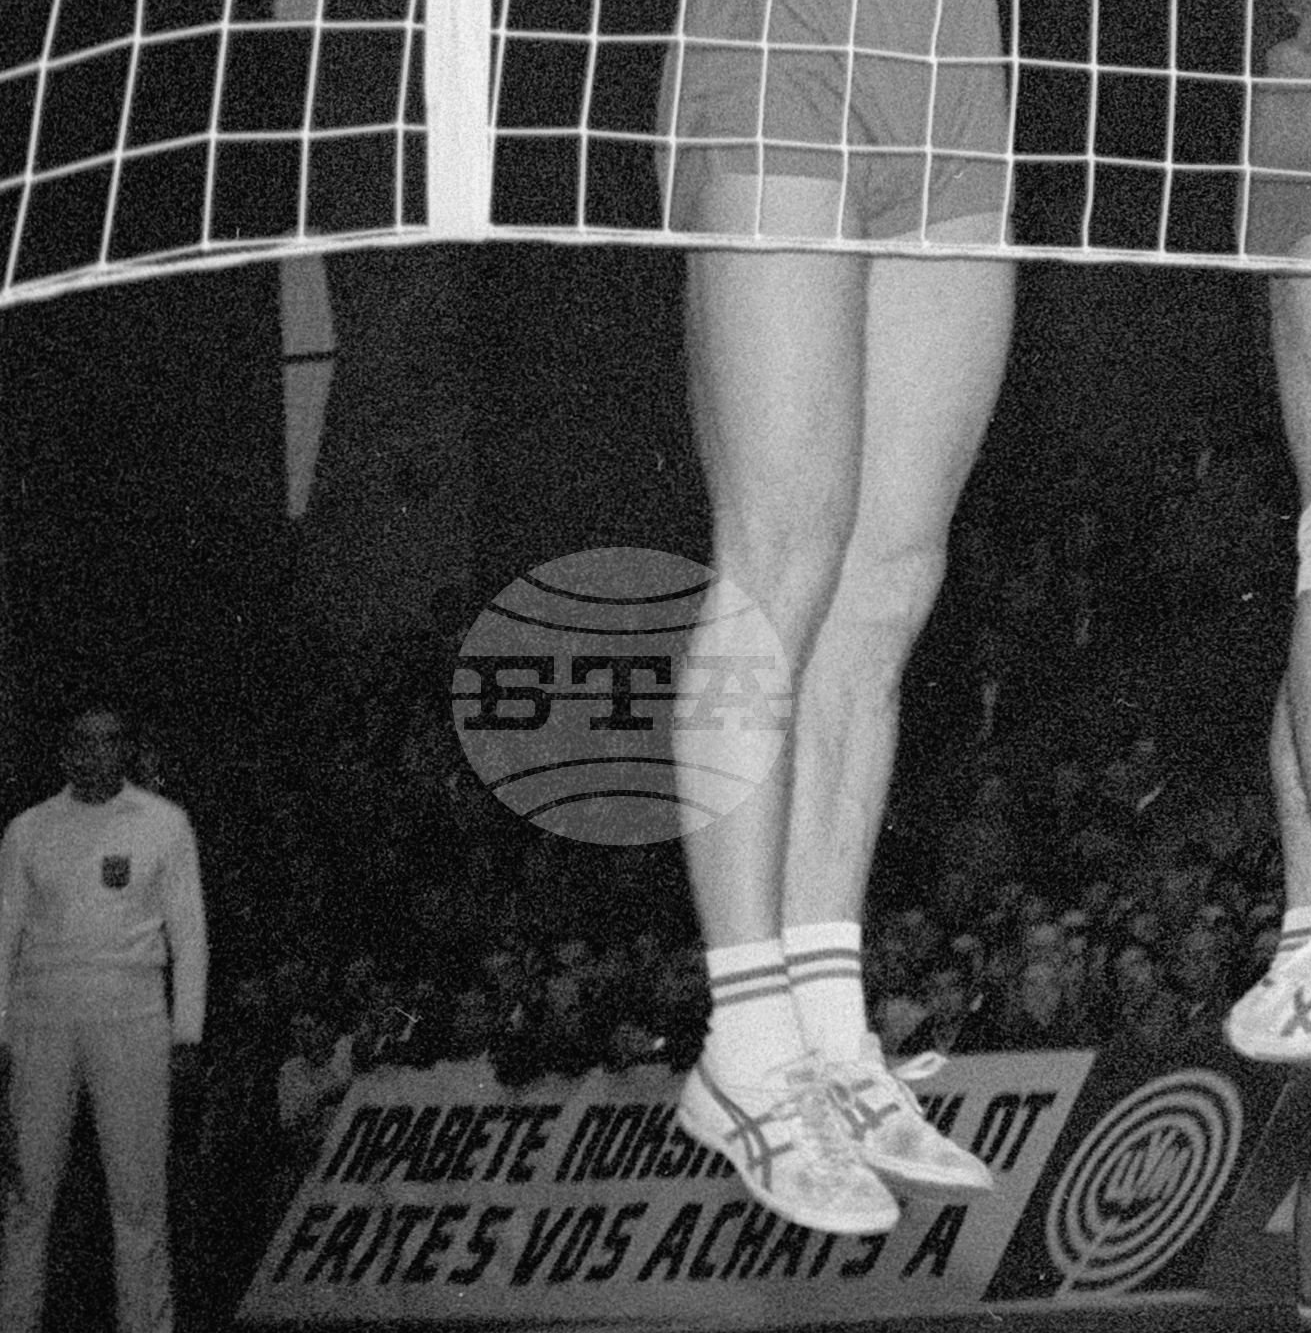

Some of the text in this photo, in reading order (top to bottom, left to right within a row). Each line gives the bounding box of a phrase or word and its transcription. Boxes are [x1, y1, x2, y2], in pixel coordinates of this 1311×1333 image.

[272, 1203, 515, 1285] FAITES
[510, 1202, 649, 1284] VOS
[902, 1204, 968, 1277] A
